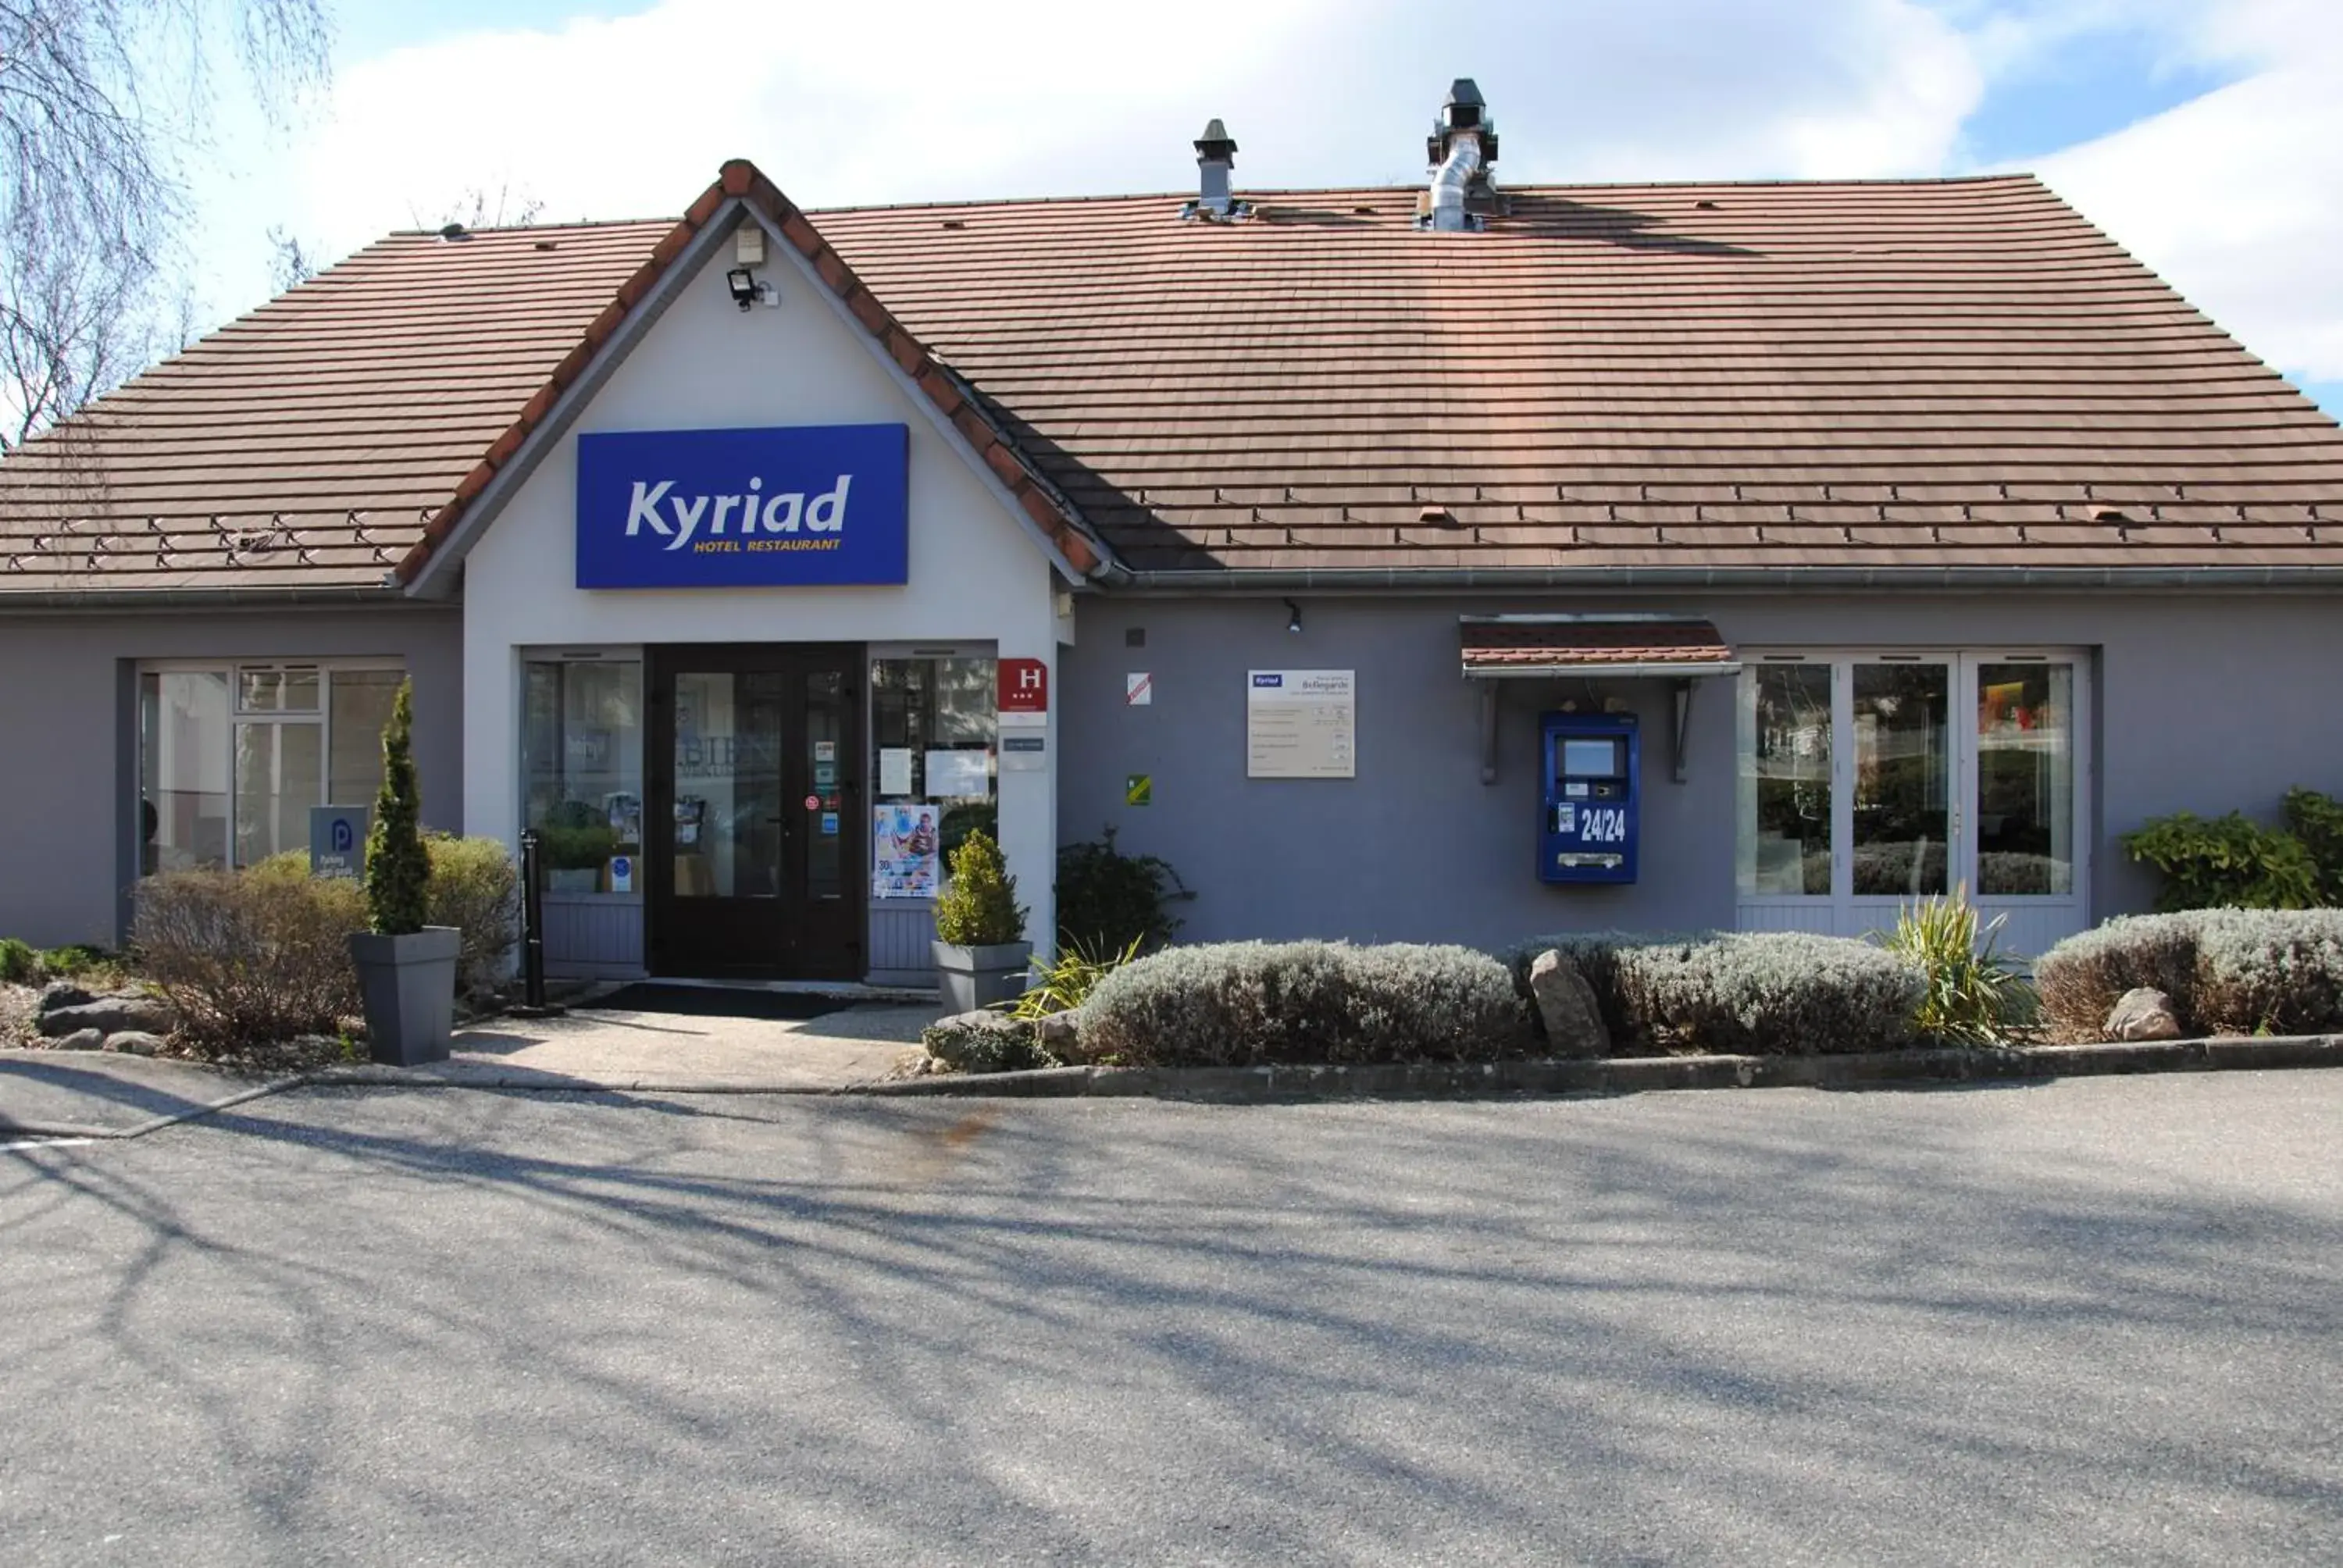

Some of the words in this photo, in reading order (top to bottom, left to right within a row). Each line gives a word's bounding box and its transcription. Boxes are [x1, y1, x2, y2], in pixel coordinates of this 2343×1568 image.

[625, 474, 853, 551] Kyriad
[694, 540, 741, 553] HOTEL
[747, 538, 841, 552] RESTAURANT
[1020, 668, 1041, 688] H
[1581, 808, 1625, 843] 24/24
